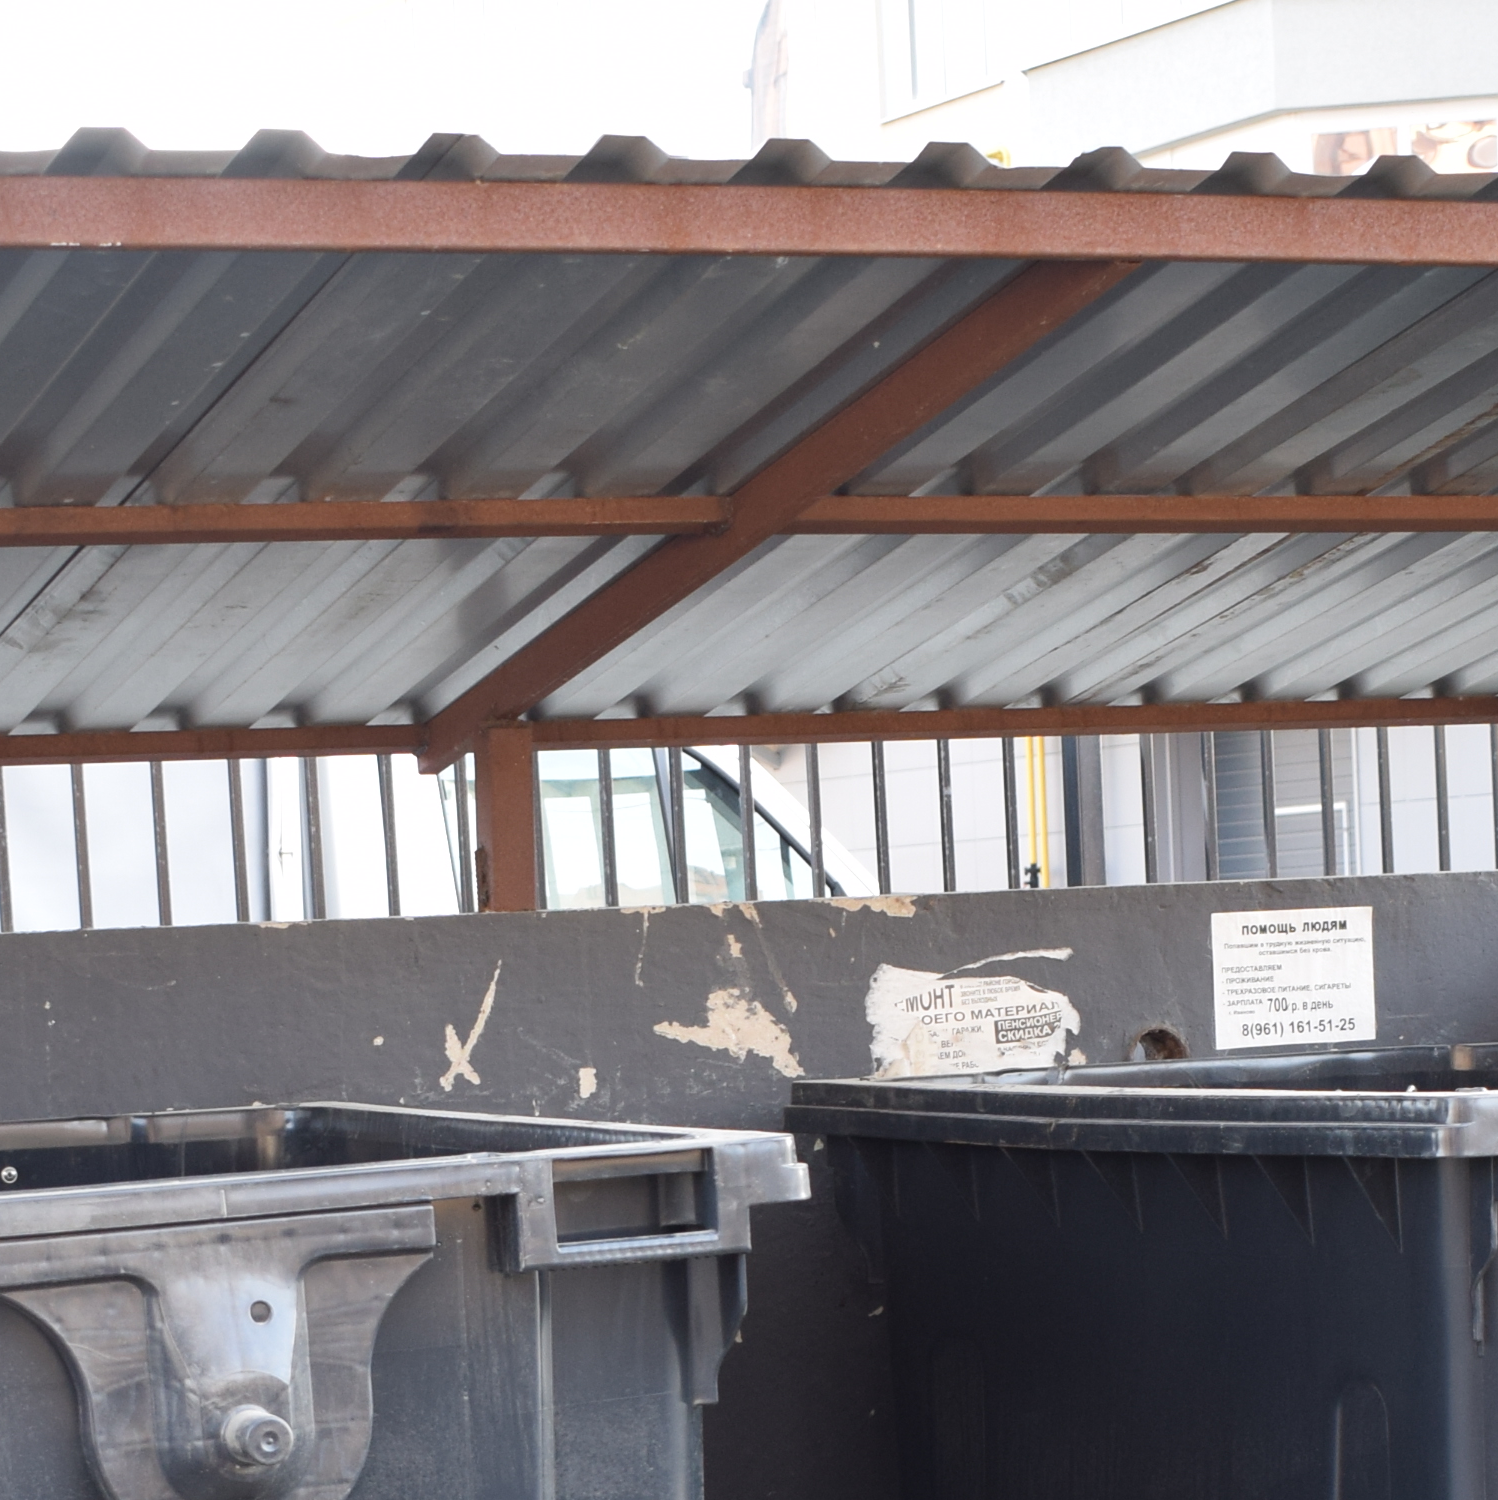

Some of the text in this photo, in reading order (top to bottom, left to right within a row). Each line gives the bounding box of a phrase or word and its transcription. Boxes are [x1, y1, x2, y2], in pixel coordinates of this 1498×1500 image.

[1242, 920, 1347, 935] ПОМОЩЬ ЛЮДЯМ
[1266, 940, 1293, 949] трудную
[1221, 964, 1282, 974] ПРЕДОСТАВЛЯЕМ
[1277, 985, 1312, 993] ПИТАНИЕ,
[1314, 983, 1351, 991] СИГАРЕТЫ
[895, 985, 955, 1013] МОНТ
[1227, 997, 1333, 1014] ЗАРПЛАТА 700 р. в день
[998, 1026, 1052, 1042] СКИДКА
[1242, 1018, 1356, 1039] 8(961) 161-51-25
